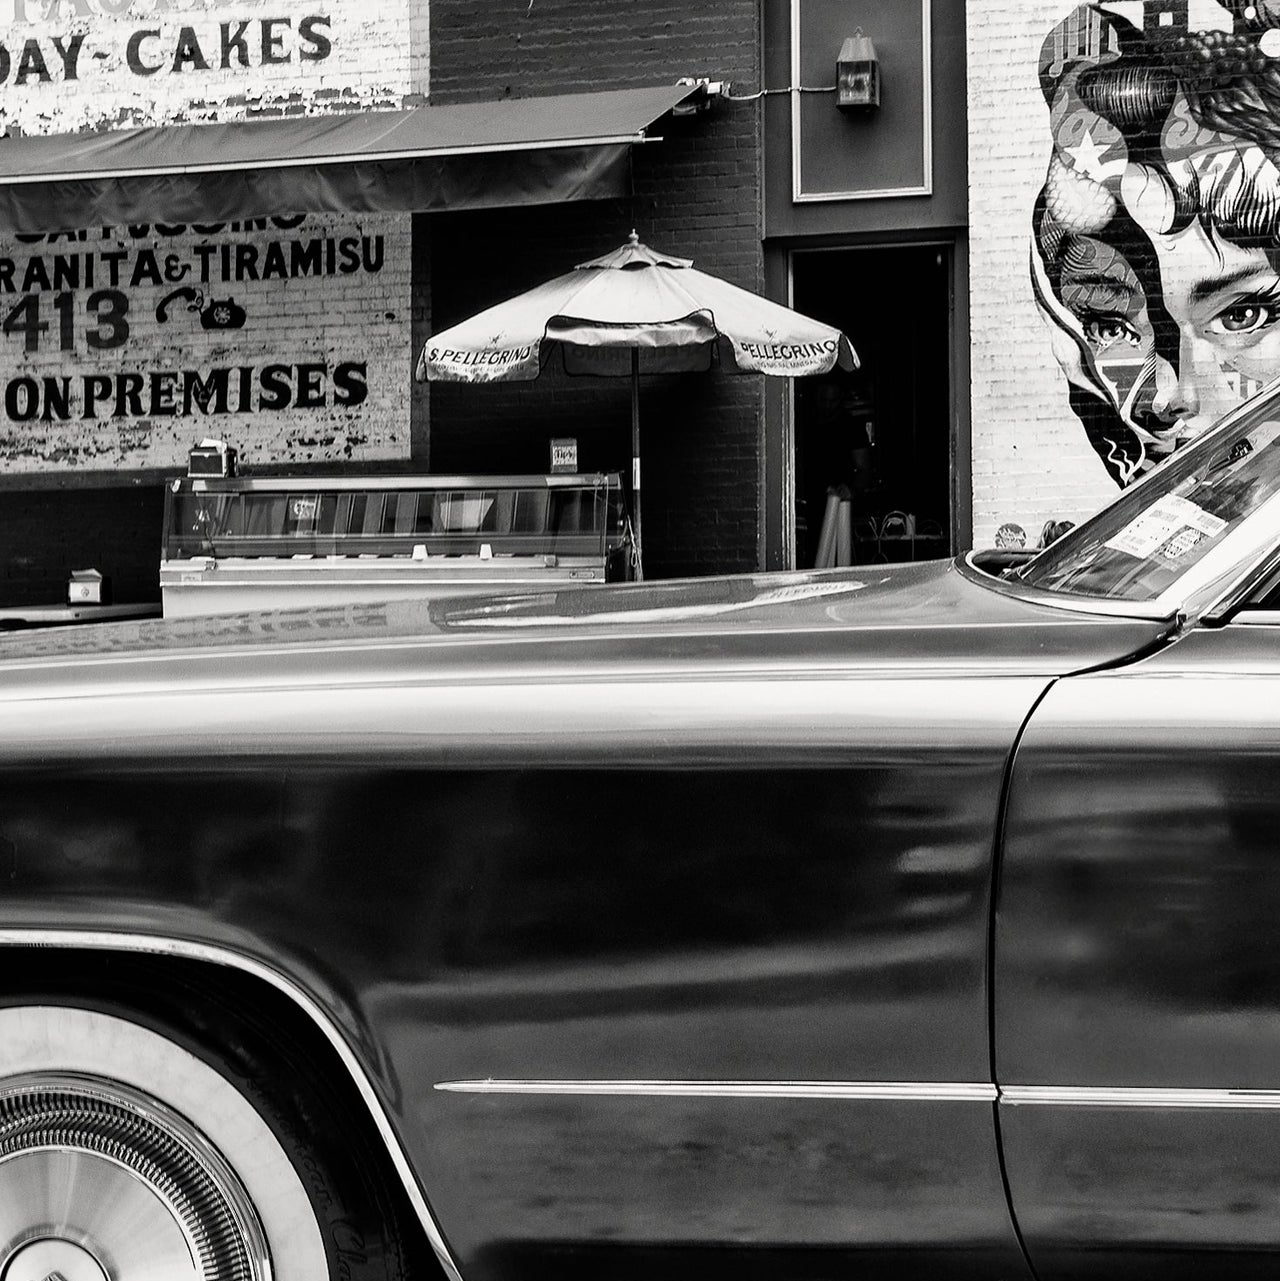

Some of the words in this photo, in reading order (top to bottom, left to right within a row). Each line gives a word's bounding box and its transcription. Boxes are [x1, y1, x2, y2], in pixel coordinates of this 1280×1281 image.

[125, 16, 332, 76] CAKES
[193, 234, 386, 282] TIRAMISU
[4, 375, 73, 422] ON
[79, 361, 369, 420] PREMISES
